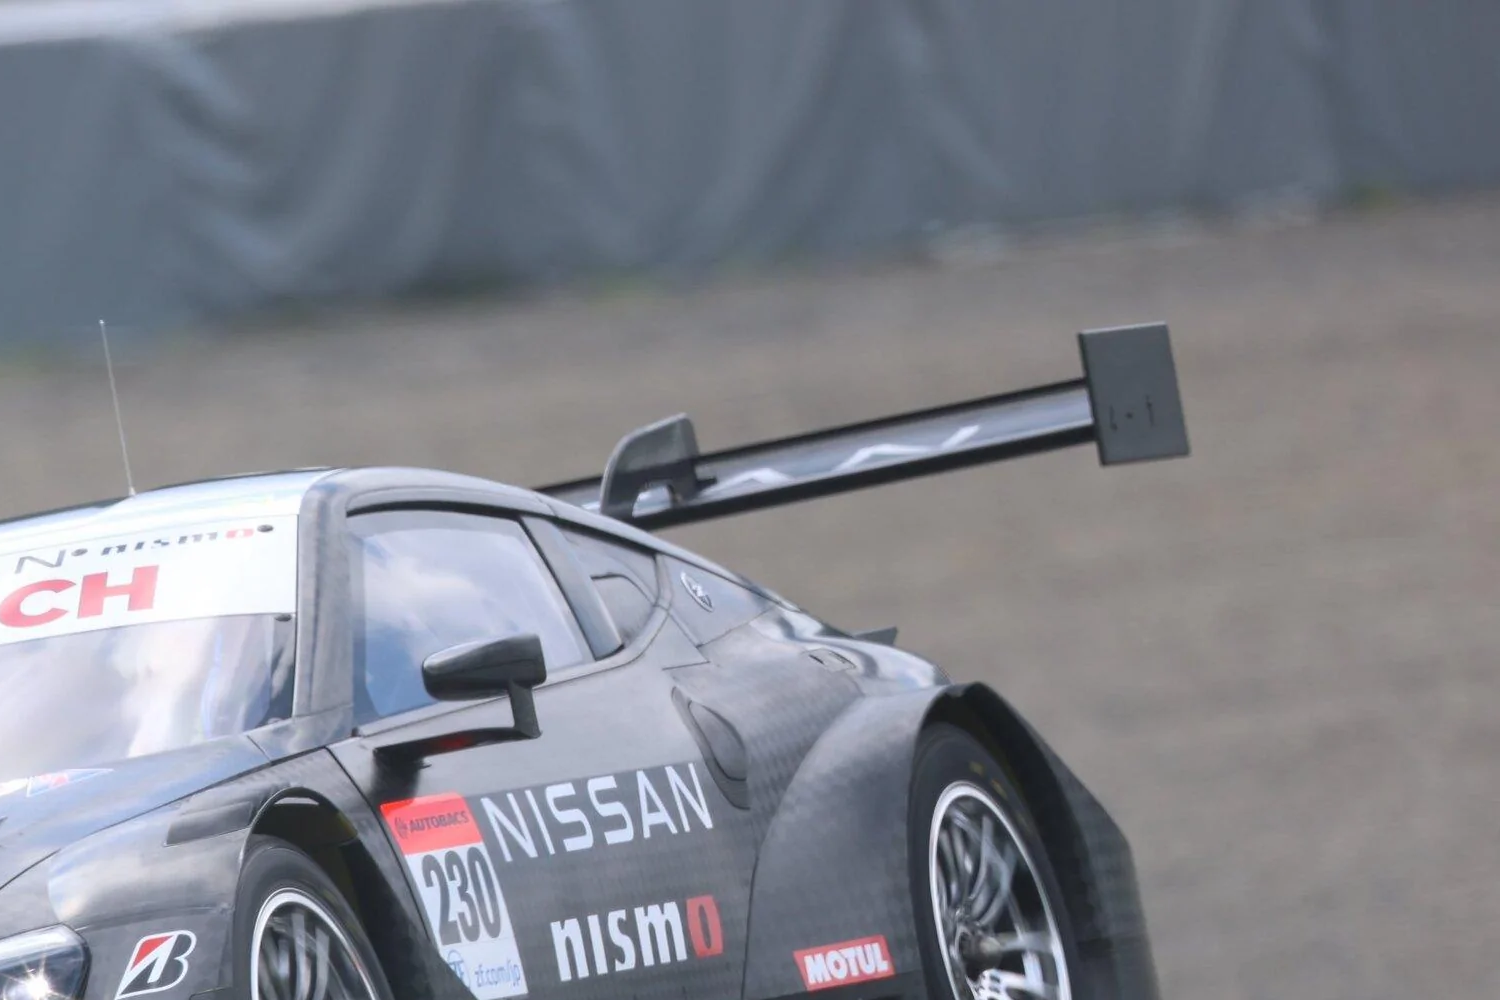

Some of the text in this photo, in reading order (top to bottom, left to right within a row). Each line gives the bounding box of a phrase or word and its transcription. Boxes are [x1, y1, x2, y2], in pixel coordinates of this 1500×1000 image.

[101, 528, 255, 557] nismo
[408, 809, 470, 835] AUTOBACS
[480, 763, 714, 863] NISSAN
[421, 846, 502, 947] 230
[550, 895, 723, 982] nismo
[803, 942, 889, 986] MOTUL
